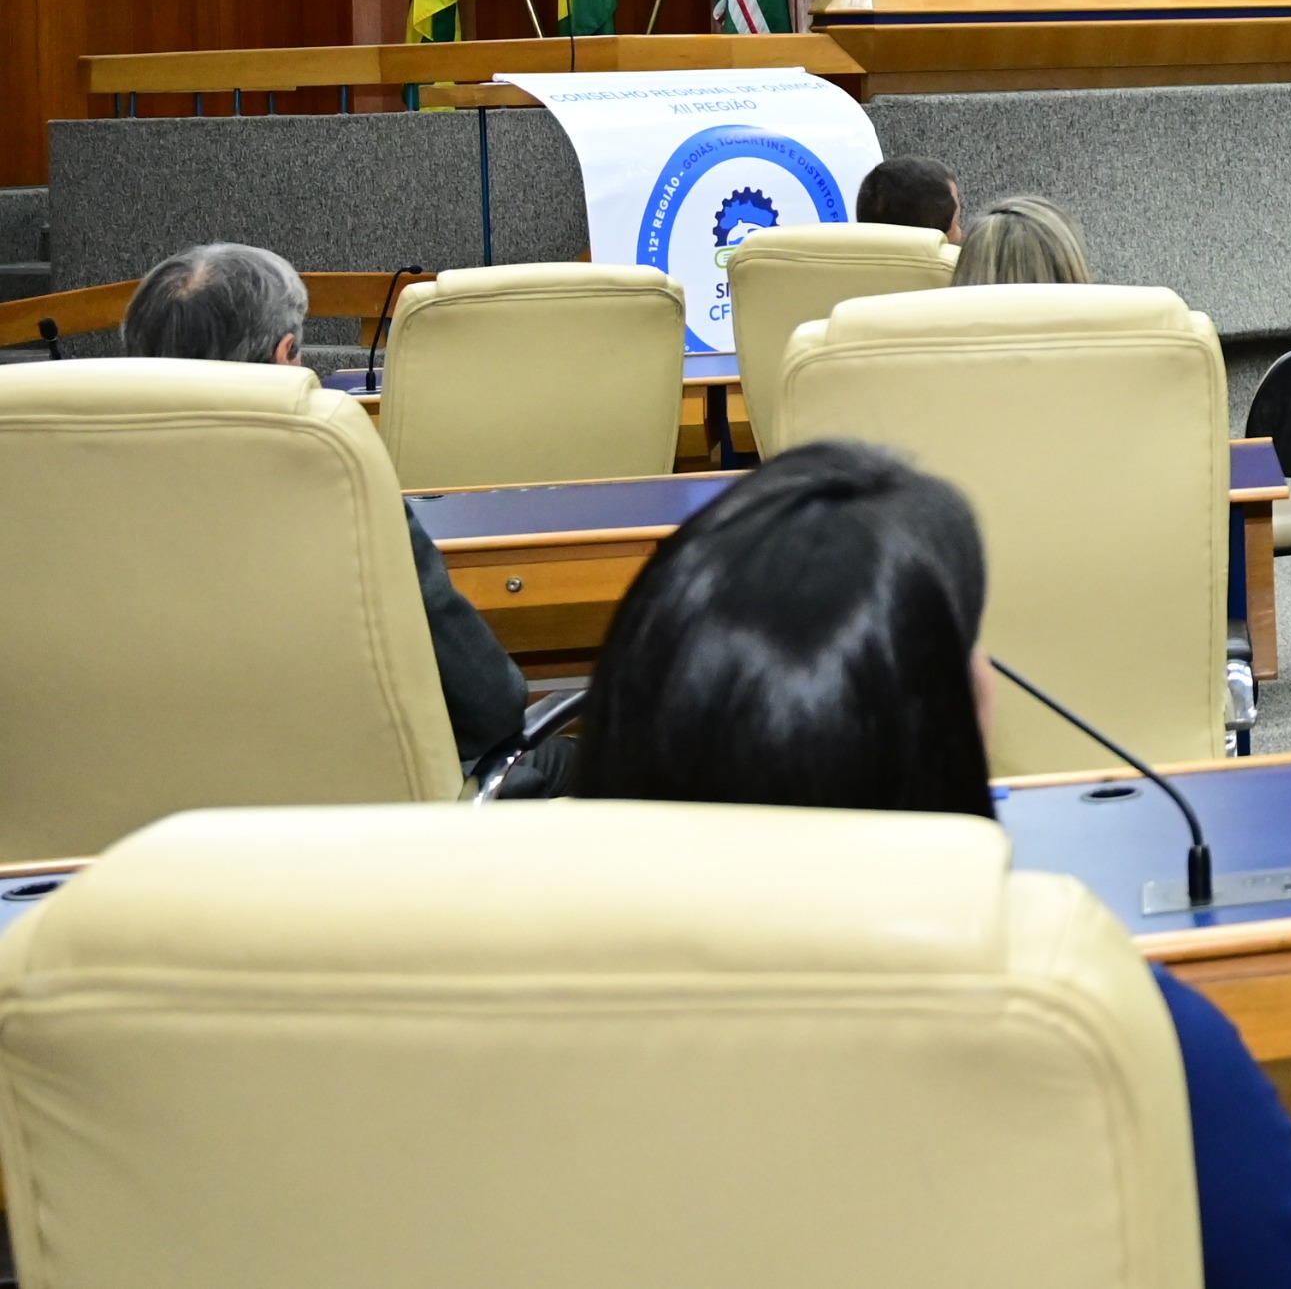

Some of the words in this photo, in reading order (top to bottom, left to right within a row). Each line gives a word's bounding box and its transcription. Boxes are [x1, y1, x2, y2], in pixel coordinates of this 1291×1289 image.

[549, 90, 648, 103] CONSELHO
[649, 86, 738, 98] REGIONAL
[737, 84, 762, 94] DE
[761, 81, 829, 93] QUÍMICA
[668, 103, 692, 115] XII
[692, 98, 758, 113] REGIÃO
[652, 176, 680, 229] REGIÃO
[717, 136, 786, 154] TOCANTINS
[788, 148, 797, 160] E
[797, 156, 835, 209] DISTRITO
[709, 303, 731, 321] CF
